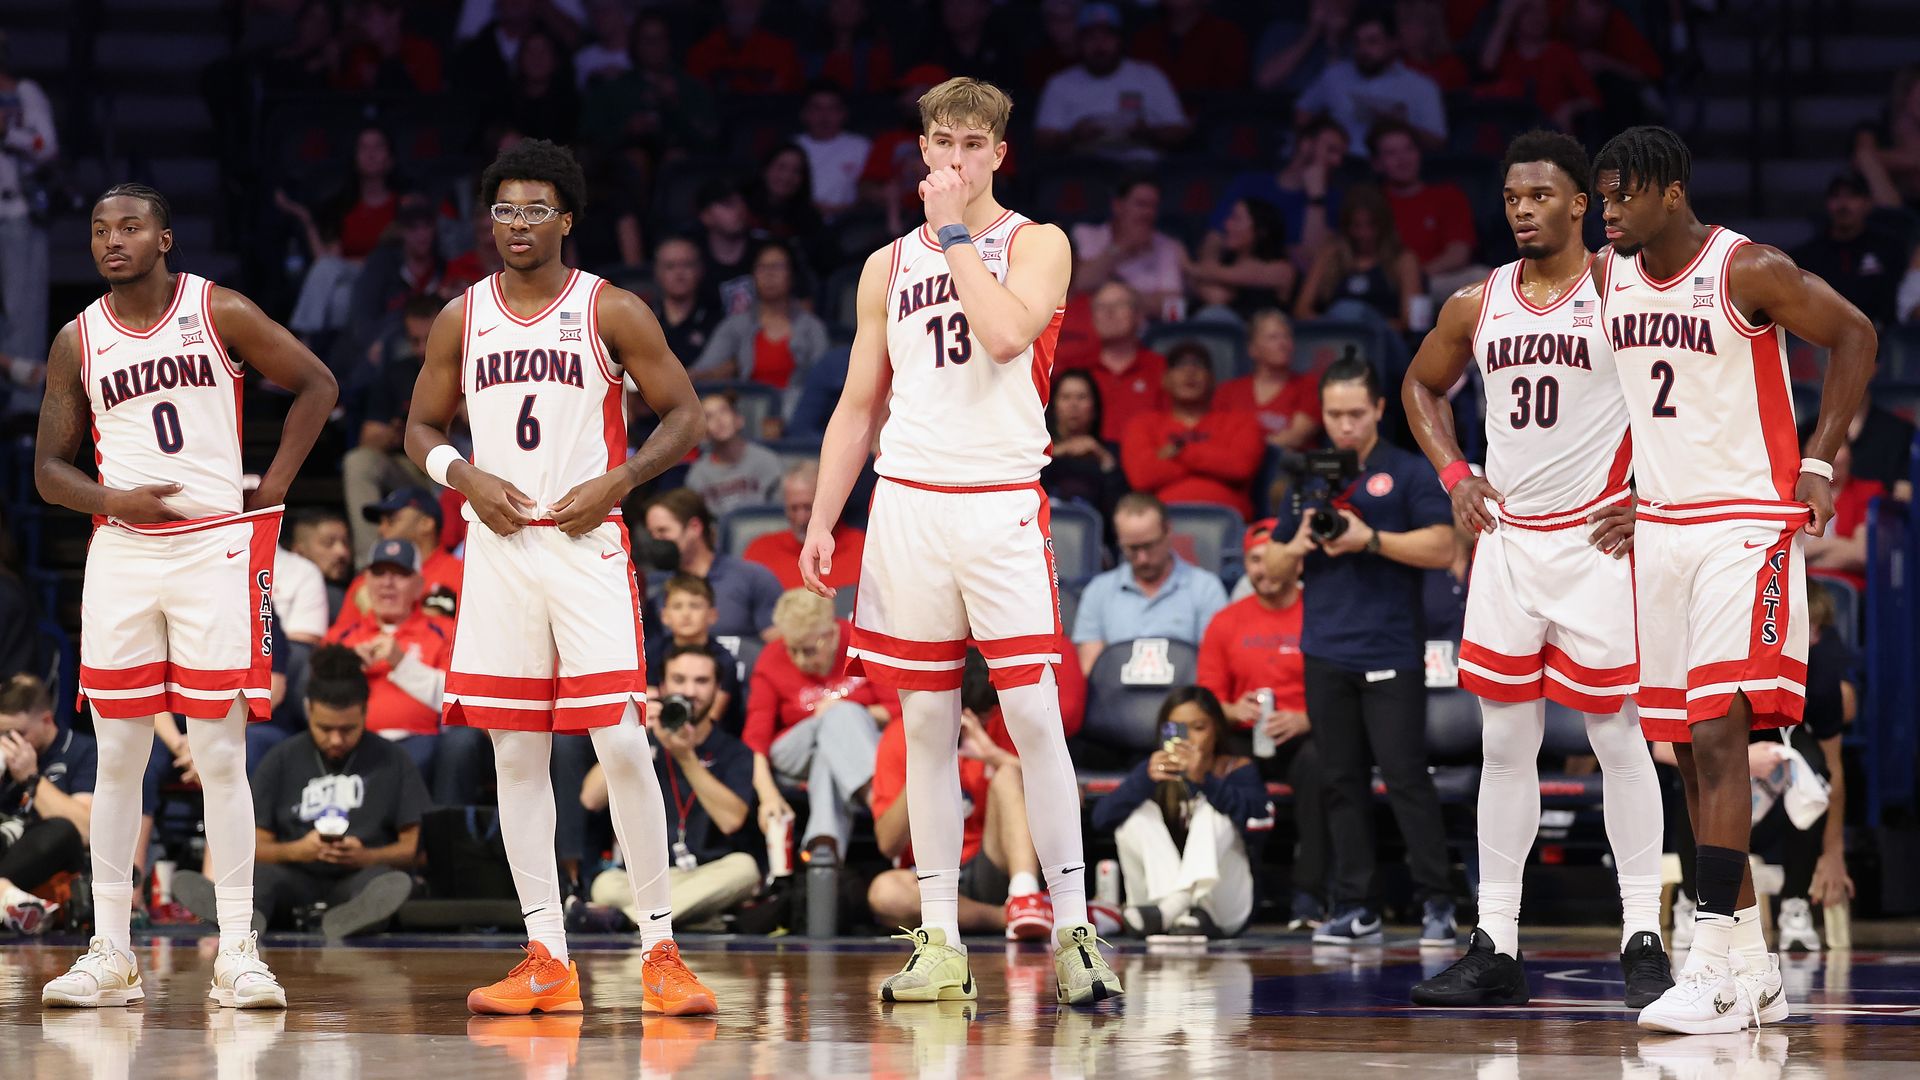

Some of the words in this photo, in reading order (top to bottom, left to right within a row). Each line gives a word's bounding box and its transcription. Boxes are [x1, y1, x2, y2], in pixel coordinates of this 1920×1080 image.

[898, 273, 960, 323] ARIZ
[926, 312, 972, 369] 13
[1487, 333, 1592, 374] ARIZONA
[1612, 313, 1717, 356] ARIZONA
[100, 354, 217, 412] ARIZONA
[475, 348, 584, 393] ARIZONA
[1650, 360, 1677, 418] 2
[152, 401, 184, 454] 0
[516, 394, 541, 451] 6
[1510, 376, 1559, 430] 30
[257, 570, 272, 656] CATS
[1762, 550, 1786, 645] CATS
